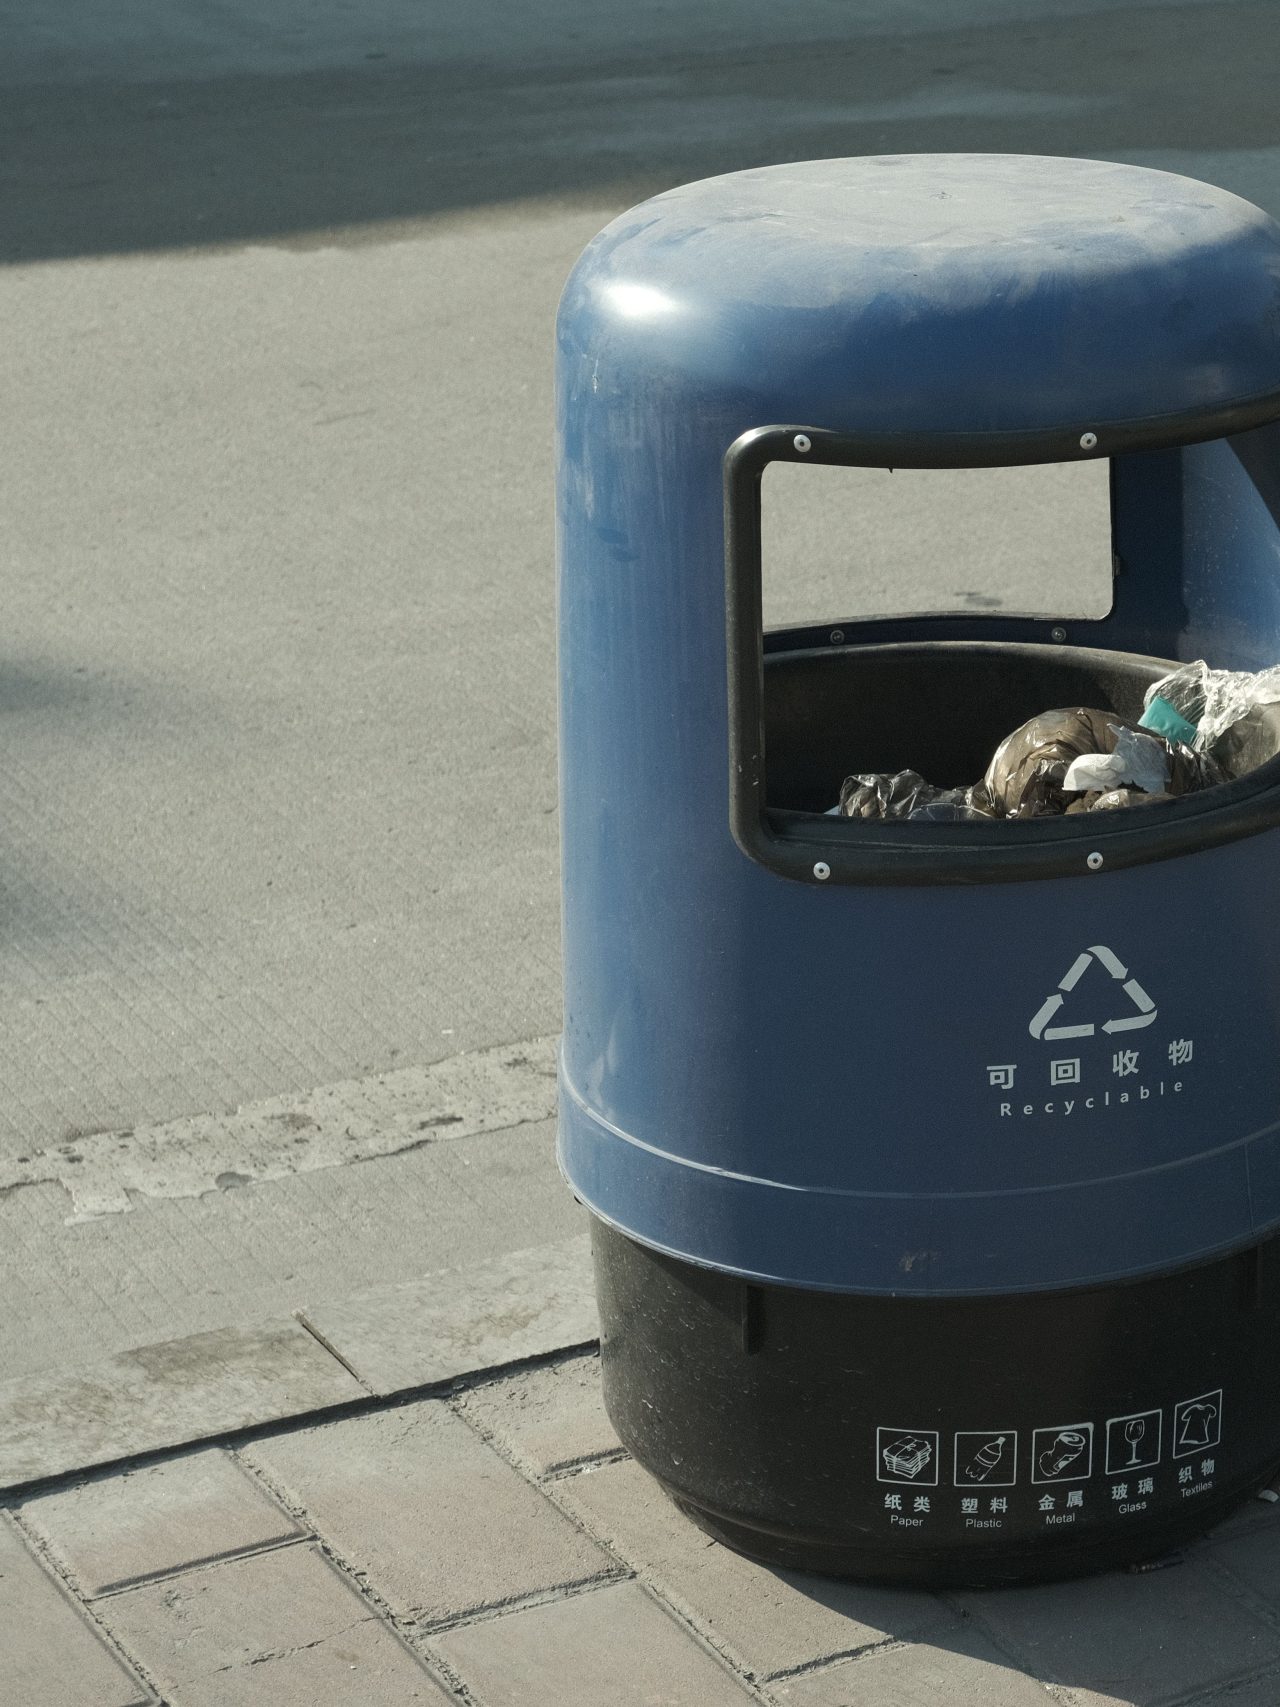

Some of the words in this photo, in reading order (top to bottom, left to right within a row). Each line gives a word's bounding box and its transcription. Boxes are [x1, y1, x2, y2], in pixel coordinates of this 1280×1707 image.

[986, 1038, 1194, 1090] 可回收物
[1000, 1080, 1183, 1116] Recyclable
[1178, 1459, 1216, 1484] 织物
[1111, 1477, 1154, 1501] 玻璃
[1180, 1479, 1213, 1499] Textiles
[884, 1493, 931, 1513] 纸类
[961, 1497, 1008, 1514] 塑料
[1038, 1490, 1084, 1512] 金属
[1118, 1500, 1147, 1515] Glass
[890, 1514, 924, 1528] Paper
[966, 1518, 1002, 1529] Plastic
[1046, 1512, 1076, 1525] Metal
